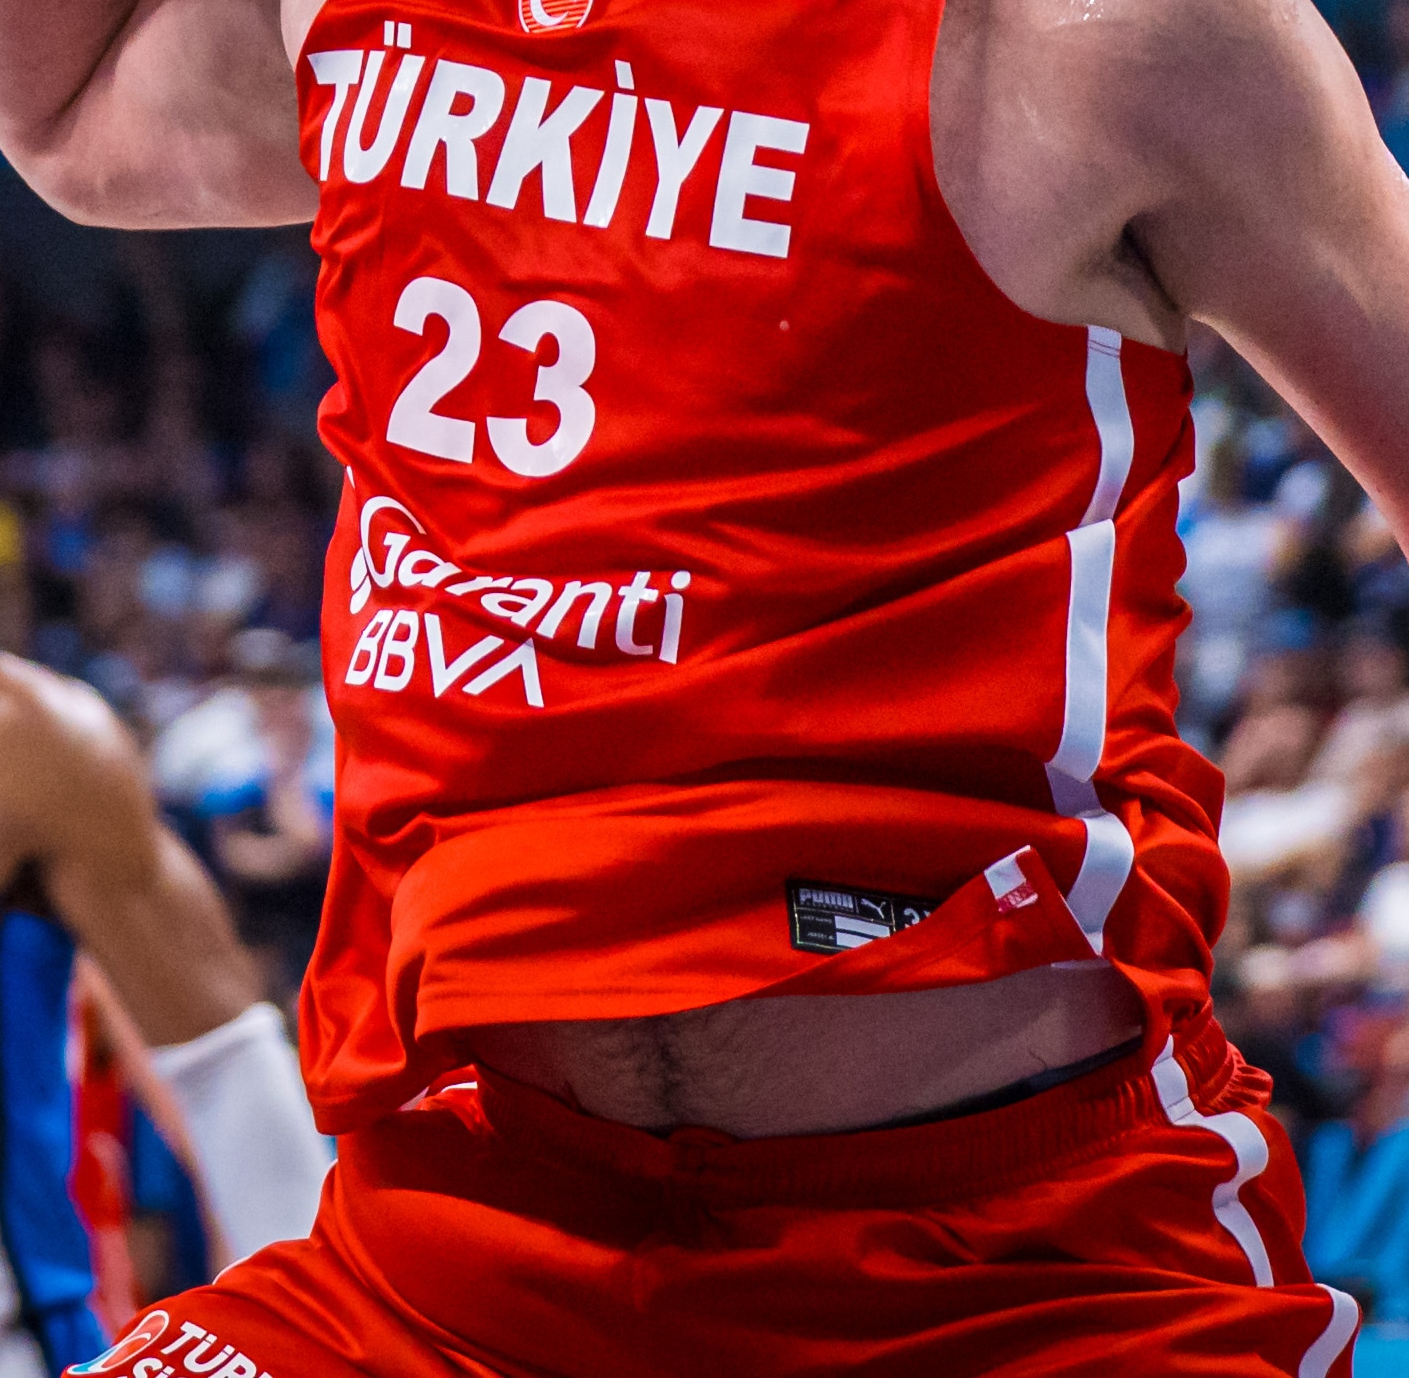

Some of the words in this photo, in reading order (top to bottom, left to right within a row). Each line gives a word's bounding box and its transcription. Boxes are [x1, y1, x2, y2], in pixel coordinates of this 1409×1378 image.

[307, 21, 810, 258] TÜRKİYE
[386, 276, 596, 477] 23
[345, 610, 545, 708] BBVA
[358, 495, 692, 665] Garanti
[160, 1321, 277, 1378] TÜR
